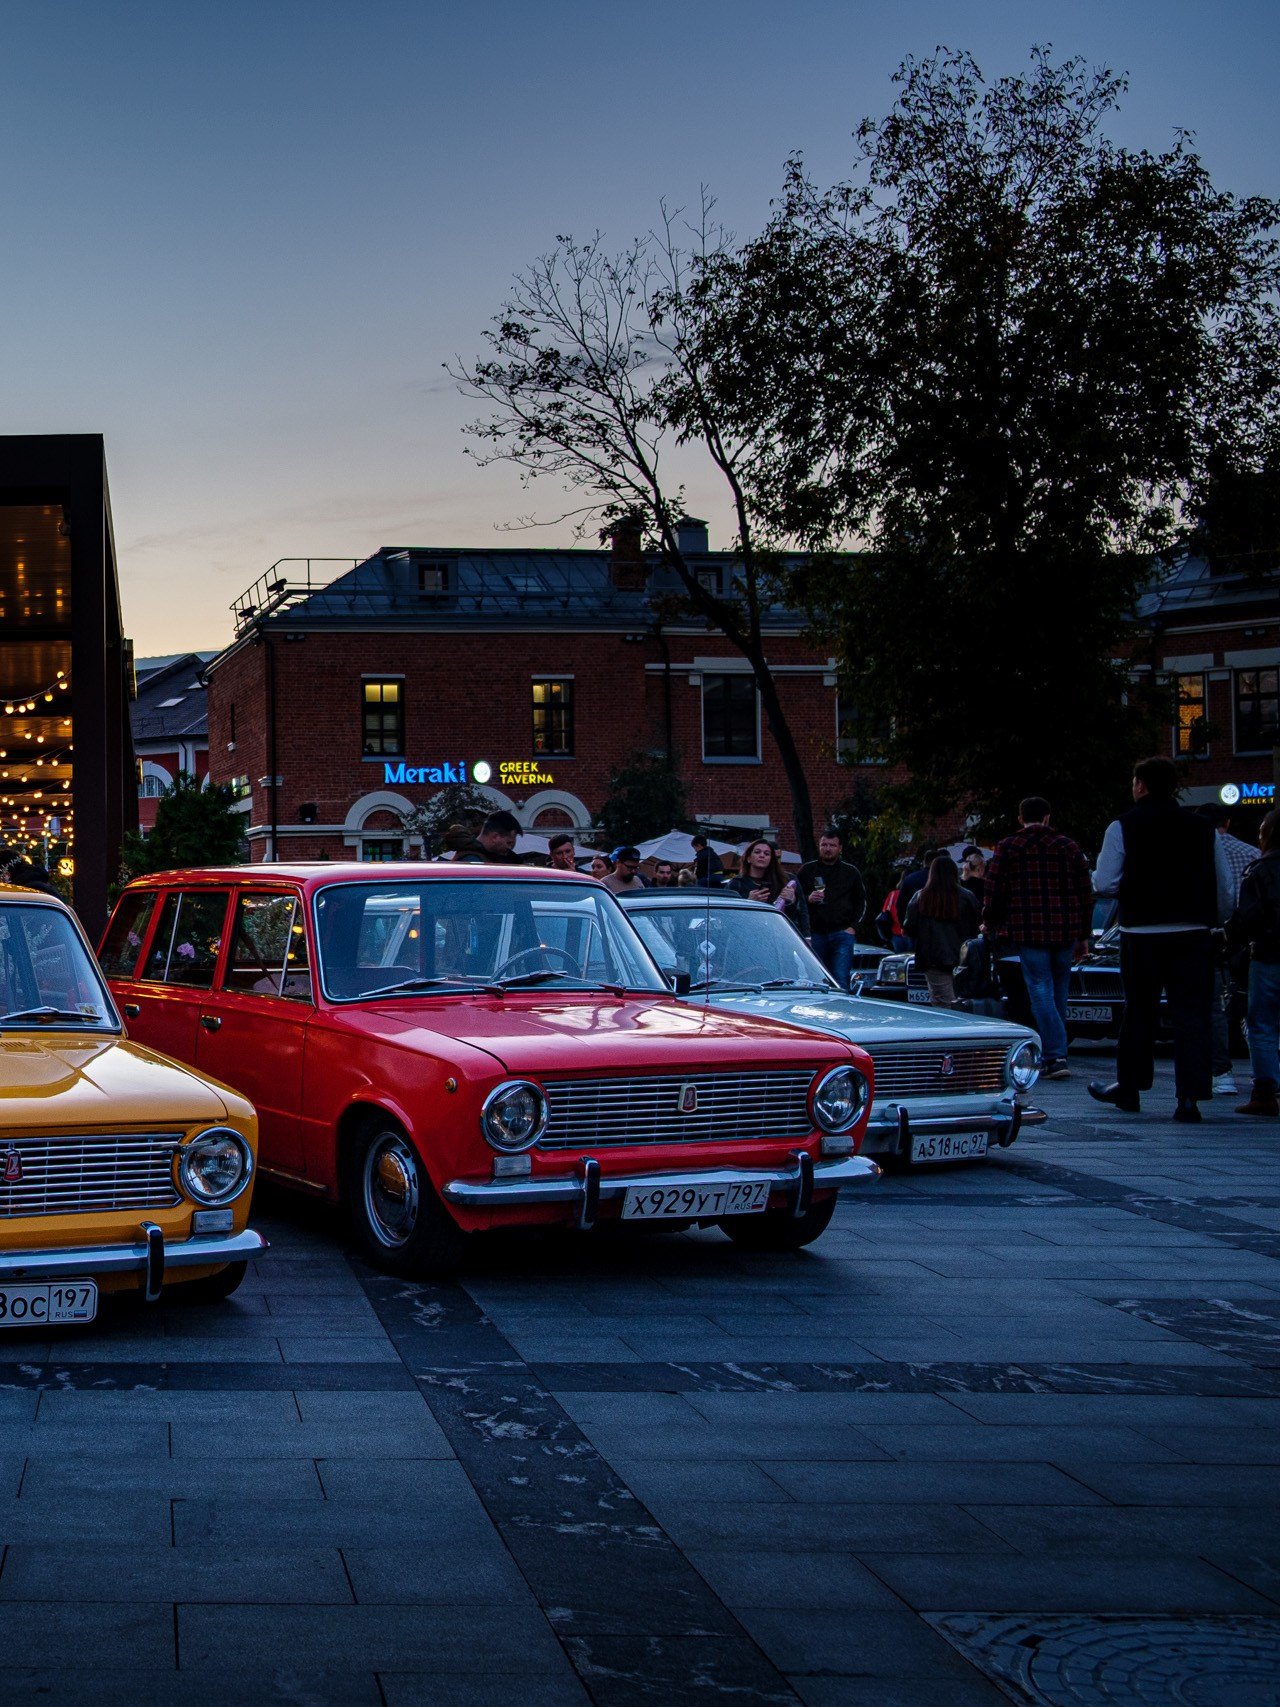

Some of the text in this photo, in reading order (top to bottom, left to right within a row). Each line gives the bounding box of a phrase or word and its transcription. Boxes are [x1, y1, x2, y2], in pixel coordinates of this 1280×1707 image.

[384, 761, 467, 784] Meraki
[499, 762, 539, 773] GREEK
[500, 774, 554, 785] TAVERNA
[917, 1133, 984, 1158] А518НС 97
[631, 1183, 765, 1215] Х929УТ 797
[734, 1202, 751, 1211] RUS
[53, 1288, 91, 1308] 197
[55, 1311, 73, 1319] RUS
